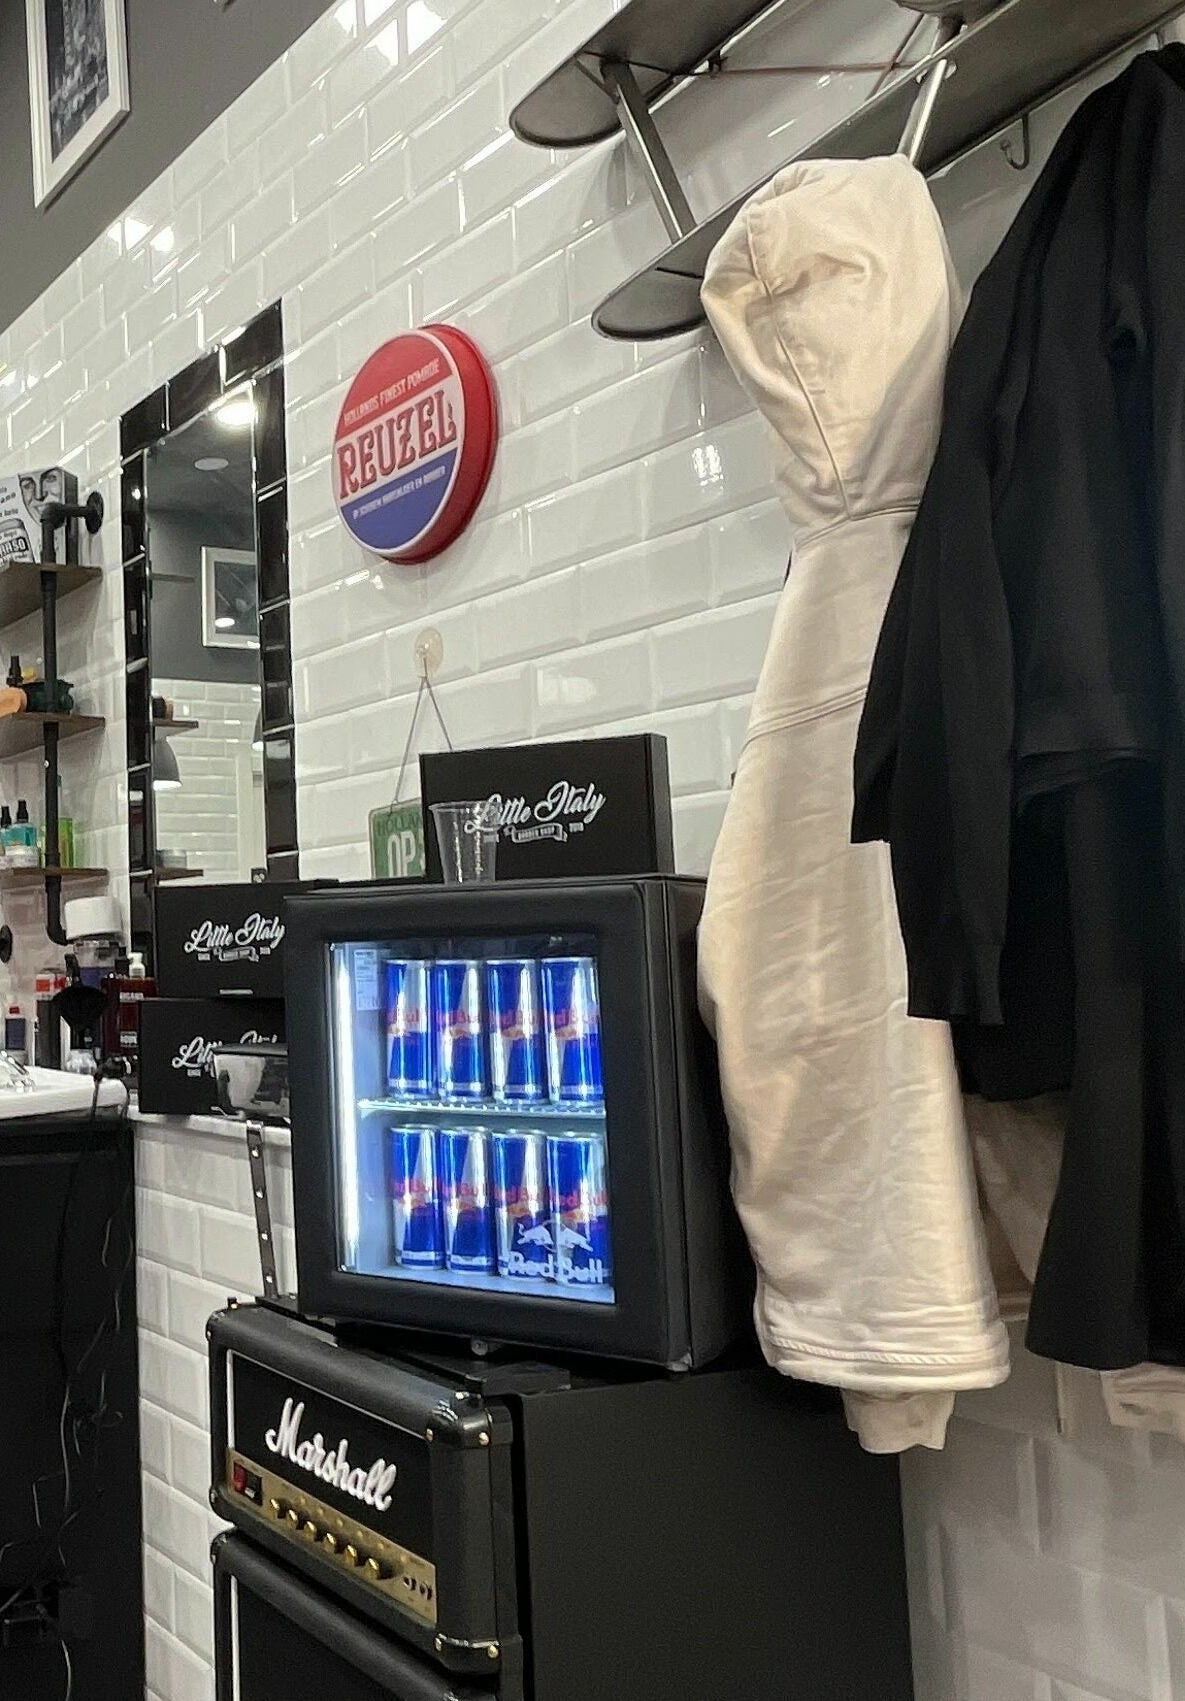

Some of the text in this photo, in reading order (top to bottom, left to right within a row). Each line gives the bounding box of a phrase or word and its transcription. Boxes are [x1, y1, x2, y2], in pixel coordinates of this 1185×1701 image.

[379, 378, 407, 408] FINEST
[336, 389, 458, 500] REUZEL
[464, 781, 606, 834] Little Italy
[387, 830, 425, 878] OP
[184, 912, 286, 953] Little Italy
[171, 1036, 223, 1069] Lit
[507, 1251, 604, 1285] Red Bull
[265, 1397, 397, 1512] Marshall
